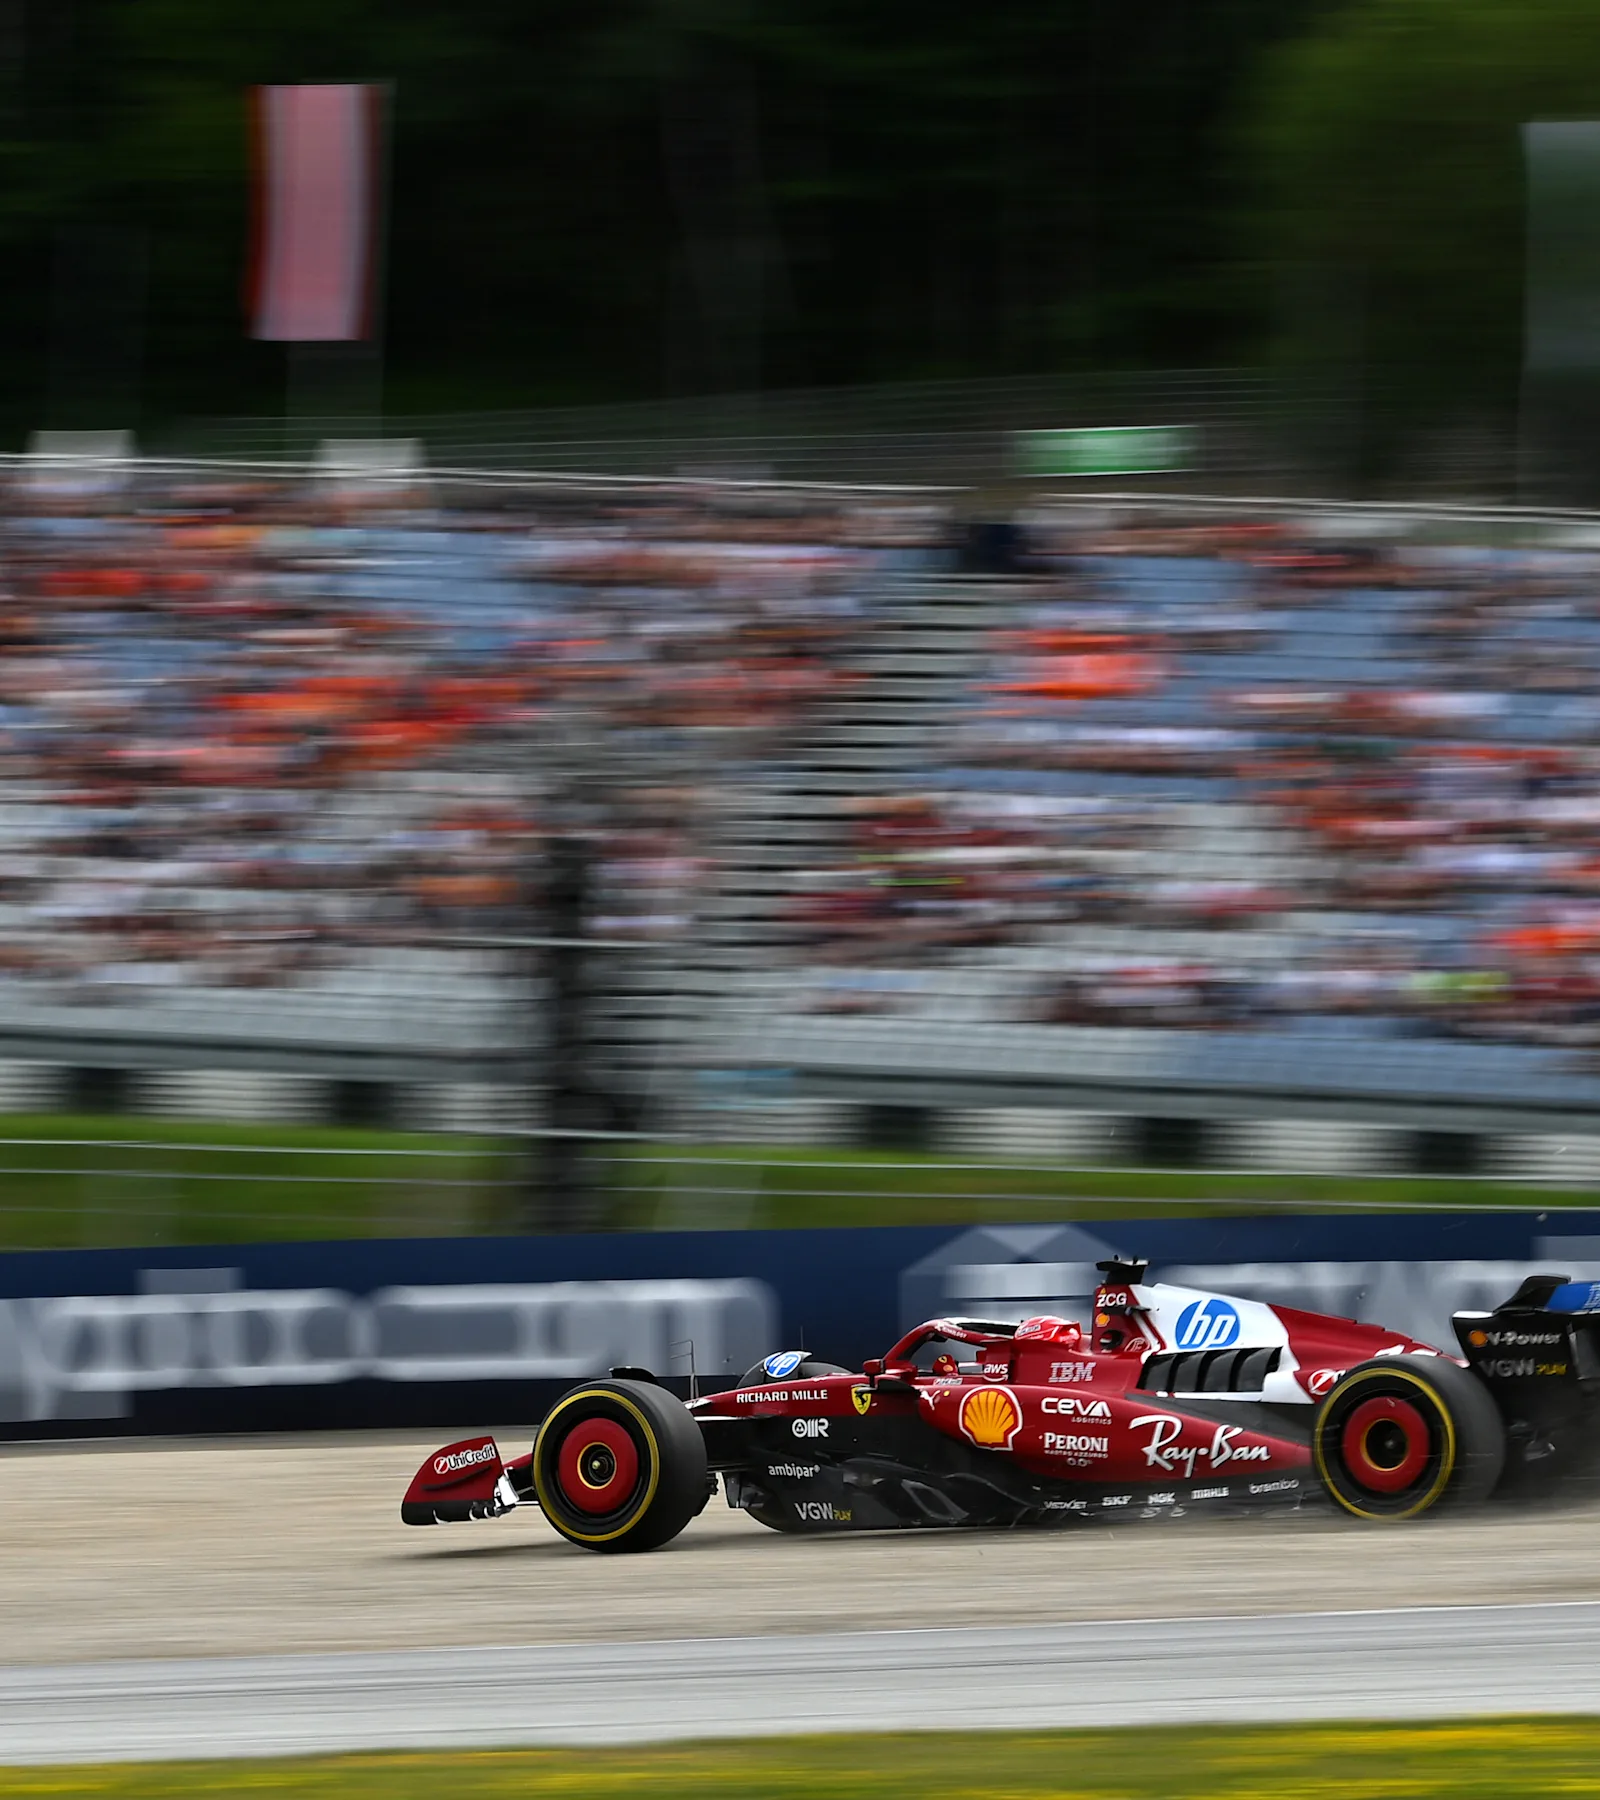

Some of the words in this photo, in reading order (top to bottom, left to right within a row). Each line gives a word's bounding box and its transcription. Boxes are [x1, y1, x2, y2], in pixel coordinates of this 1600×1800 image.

[1096, 1293, 1127, 1308] ZCG
[1179, 1299, 1236, 1348] hp
[1487, 1331, 1562, 1346] V-Power
[984, 1363, 1008, 1374] aws
[1048, 1362, 1096, 1383] IBM
[736, 1391, 789, 1403] RICHARD
[792, 1389, 828, 1401] MILLE
[1072, 1416, 1112, 1425] LOGISTICS
[1044, 1432, 1108, 1452] PERONI
[1128, 1414, 1271, 1478] Ray-Ban
[447, 1444, 496, 1470] UniCredit
[1191, 1486, 1229, 1500] MAHLE
[1249, 1479, 1299, 1494] brembo
[1102, 1495, 1132, 1506] SKF
[1148, 1492, 1176, 1505] NGK
[794, 1502, 834, 1521] VGW
